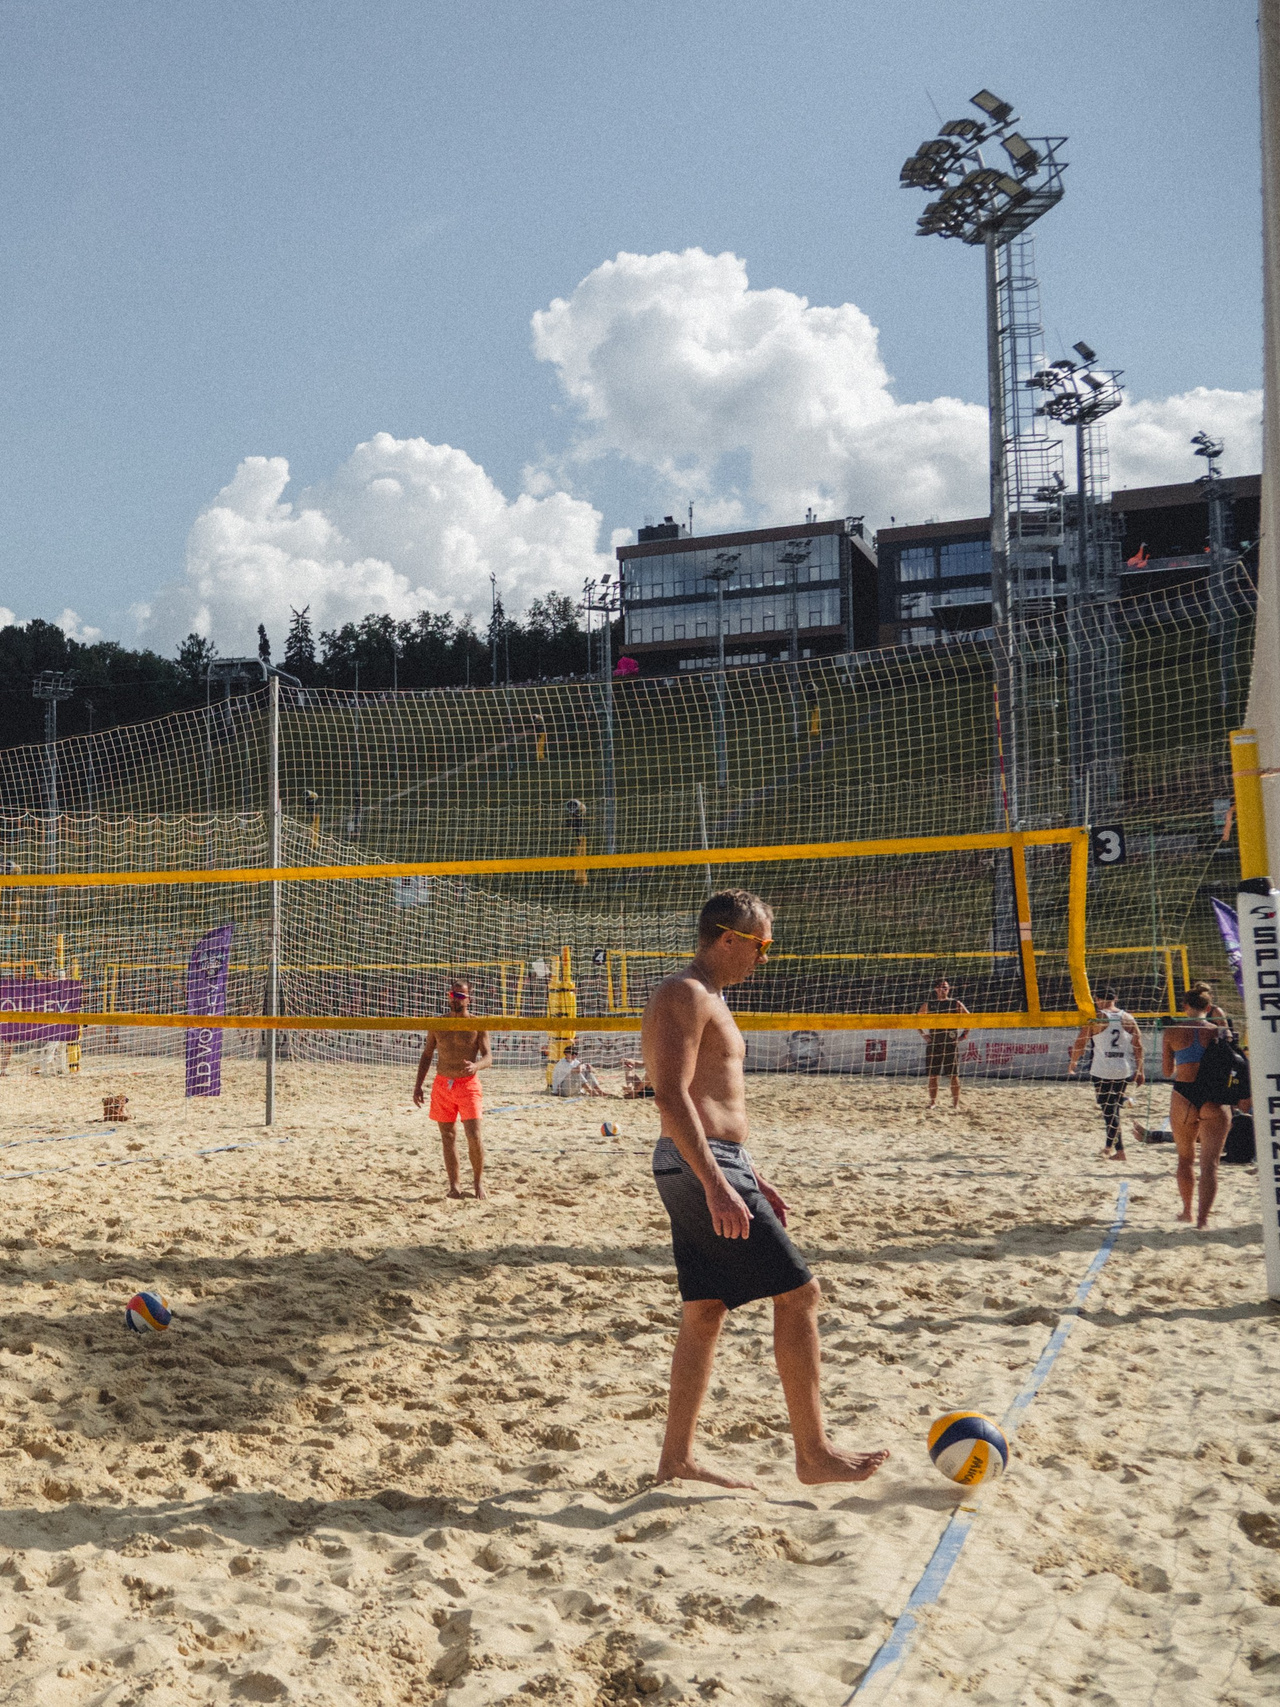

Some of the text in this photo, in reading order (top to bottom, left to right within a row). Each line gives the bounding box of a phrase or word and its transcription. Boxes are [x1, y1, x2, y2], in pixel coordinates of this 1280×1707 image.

[1097, 831, 1120, 861] 3
[595, 952, 604, 963] 4
[197, 983, 218, 1057] VOLEY
[1111, 1029, 1120, 1047] 2
